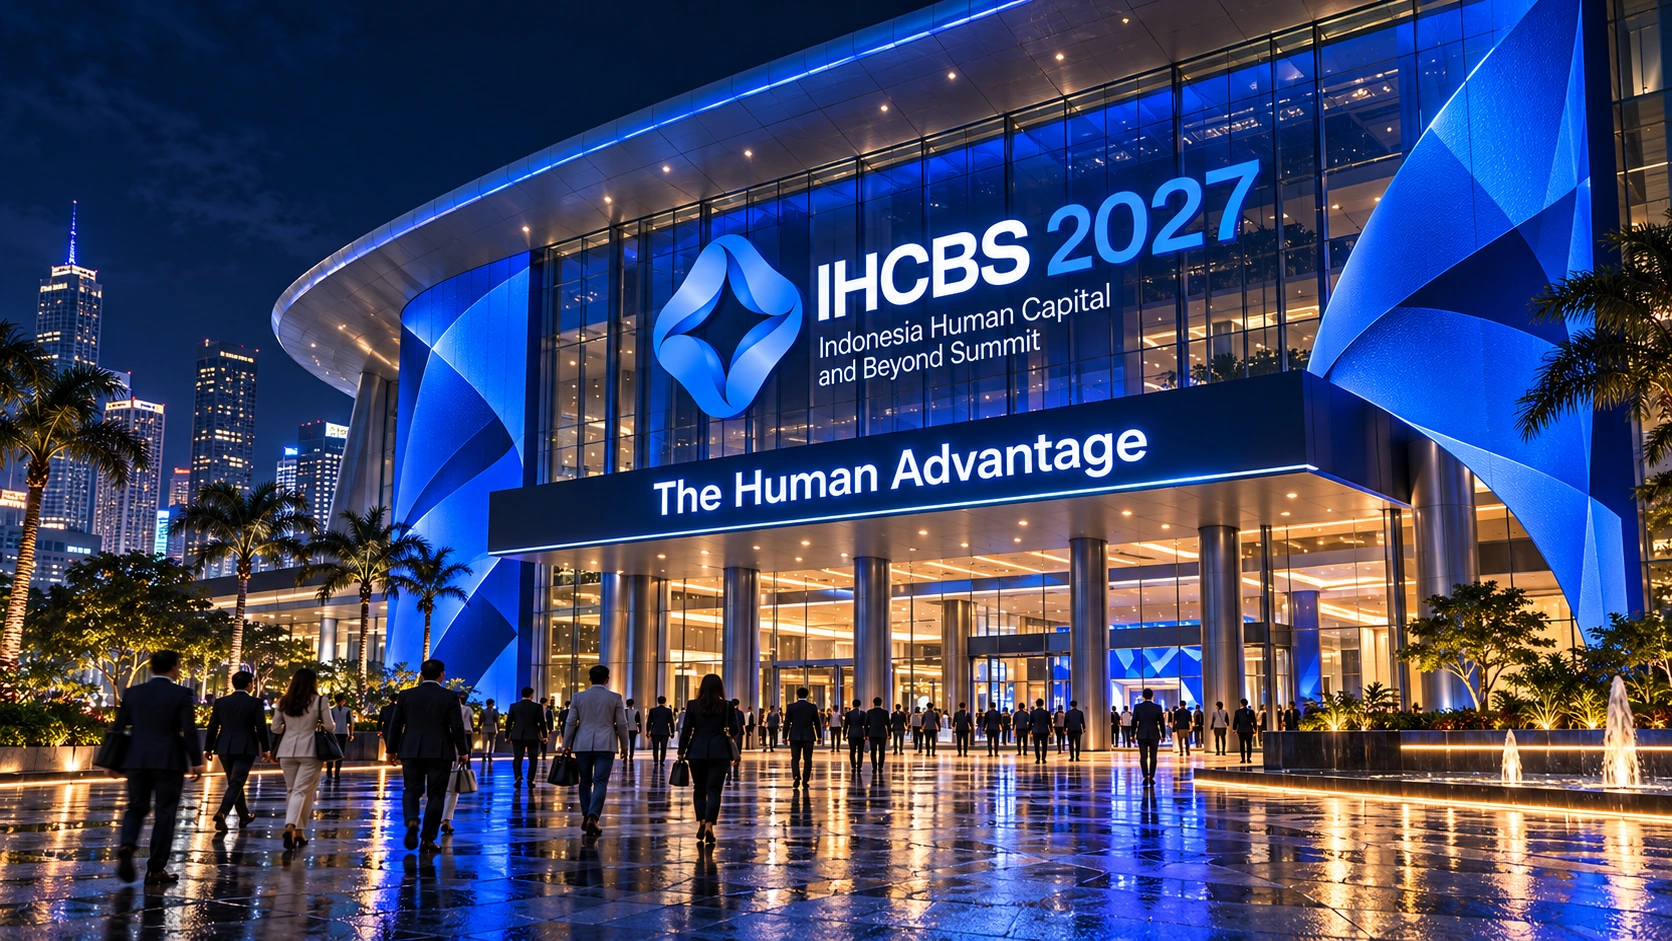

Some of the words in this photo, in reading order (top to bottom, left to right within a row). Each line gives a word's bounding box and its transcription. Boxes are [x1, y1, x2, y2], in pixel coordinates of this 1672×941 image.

[818, 219, 1030, 322] IHCBS
[1046, 158, 1261, 277] 2027
[818, 358, 856, 387] and
[863, 343, 943, 380] Beyond
[951, 329, 1041, 364] Summit
[819, 320, 923, 359] Indonesia
[931, 308, 1014, 339] Human
[1022, 282, 1111, 323] Capital
[653, 480, 722, 516] The
[735, 464, 878, 508] Human
[890, 429, 1148, 490] Advantage
